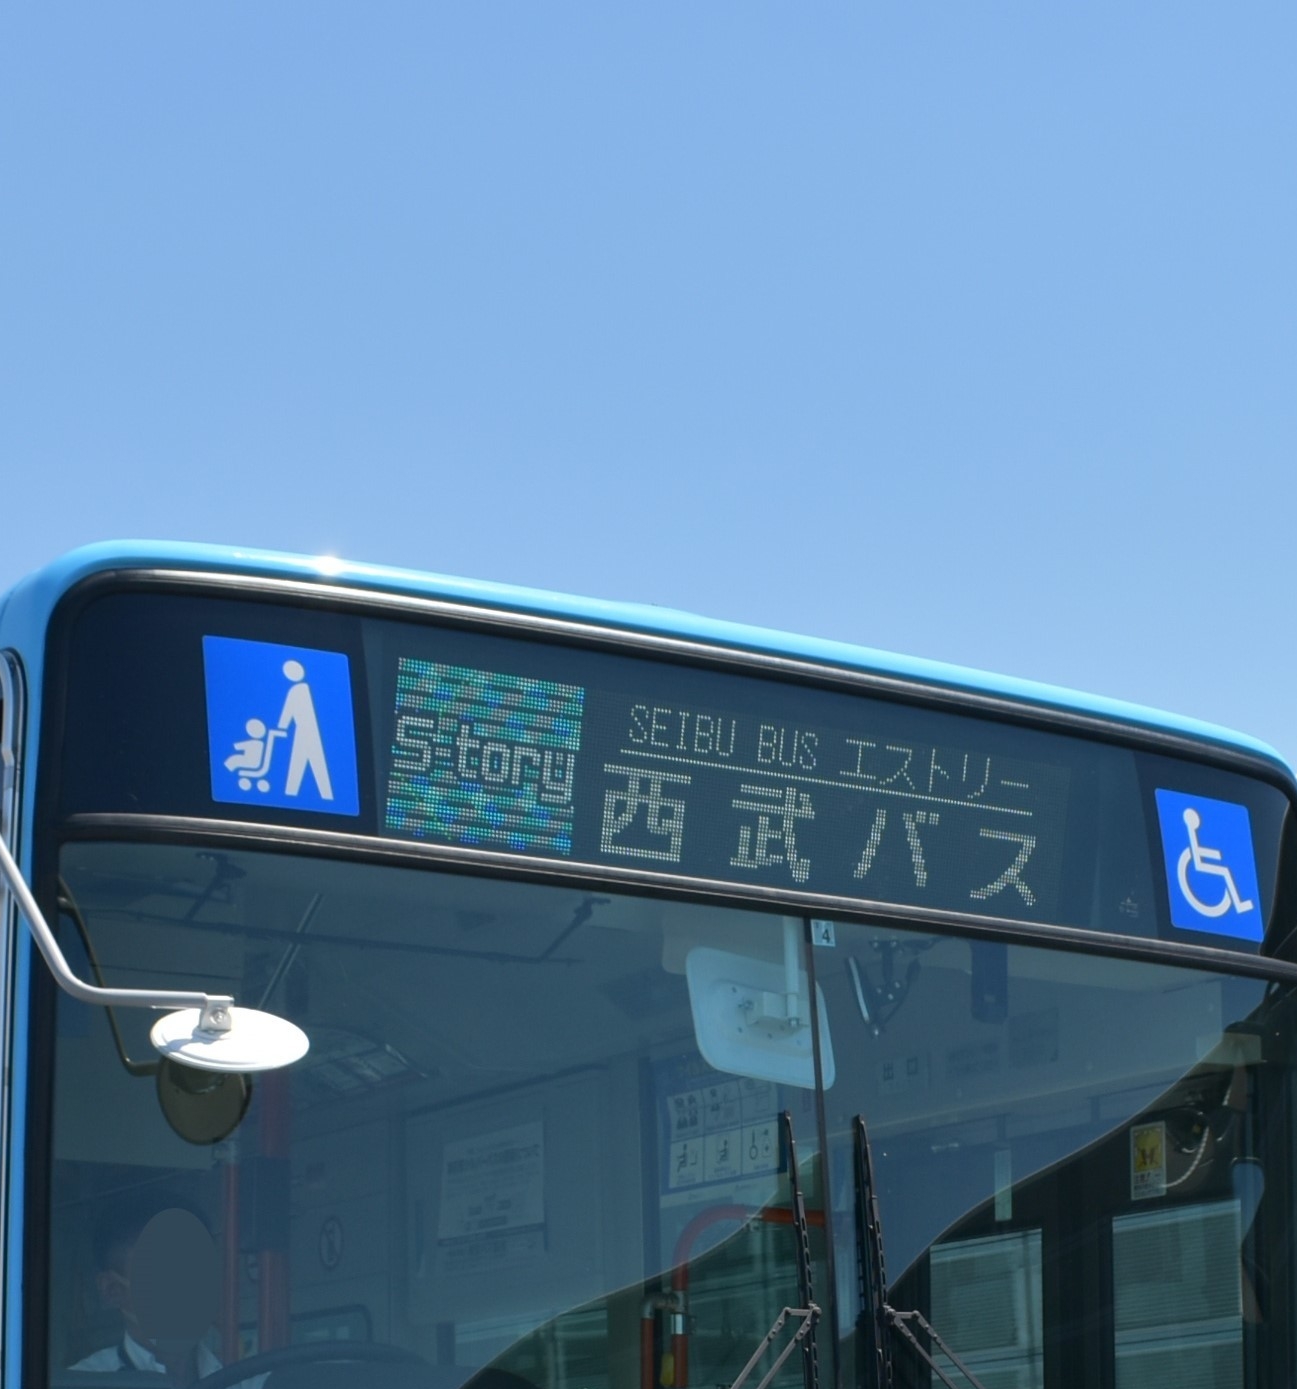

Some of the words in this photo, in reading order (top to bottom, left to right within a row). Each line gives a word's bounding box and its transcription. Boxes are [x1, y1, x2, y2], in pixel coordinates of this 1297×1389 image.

[628, 703, 737, 758] SEIBU
[756, 723, 820, 770] BUS
[839, 737, 1030, 800] エストリー
[600, 762, 1037, 907] 西武バス
